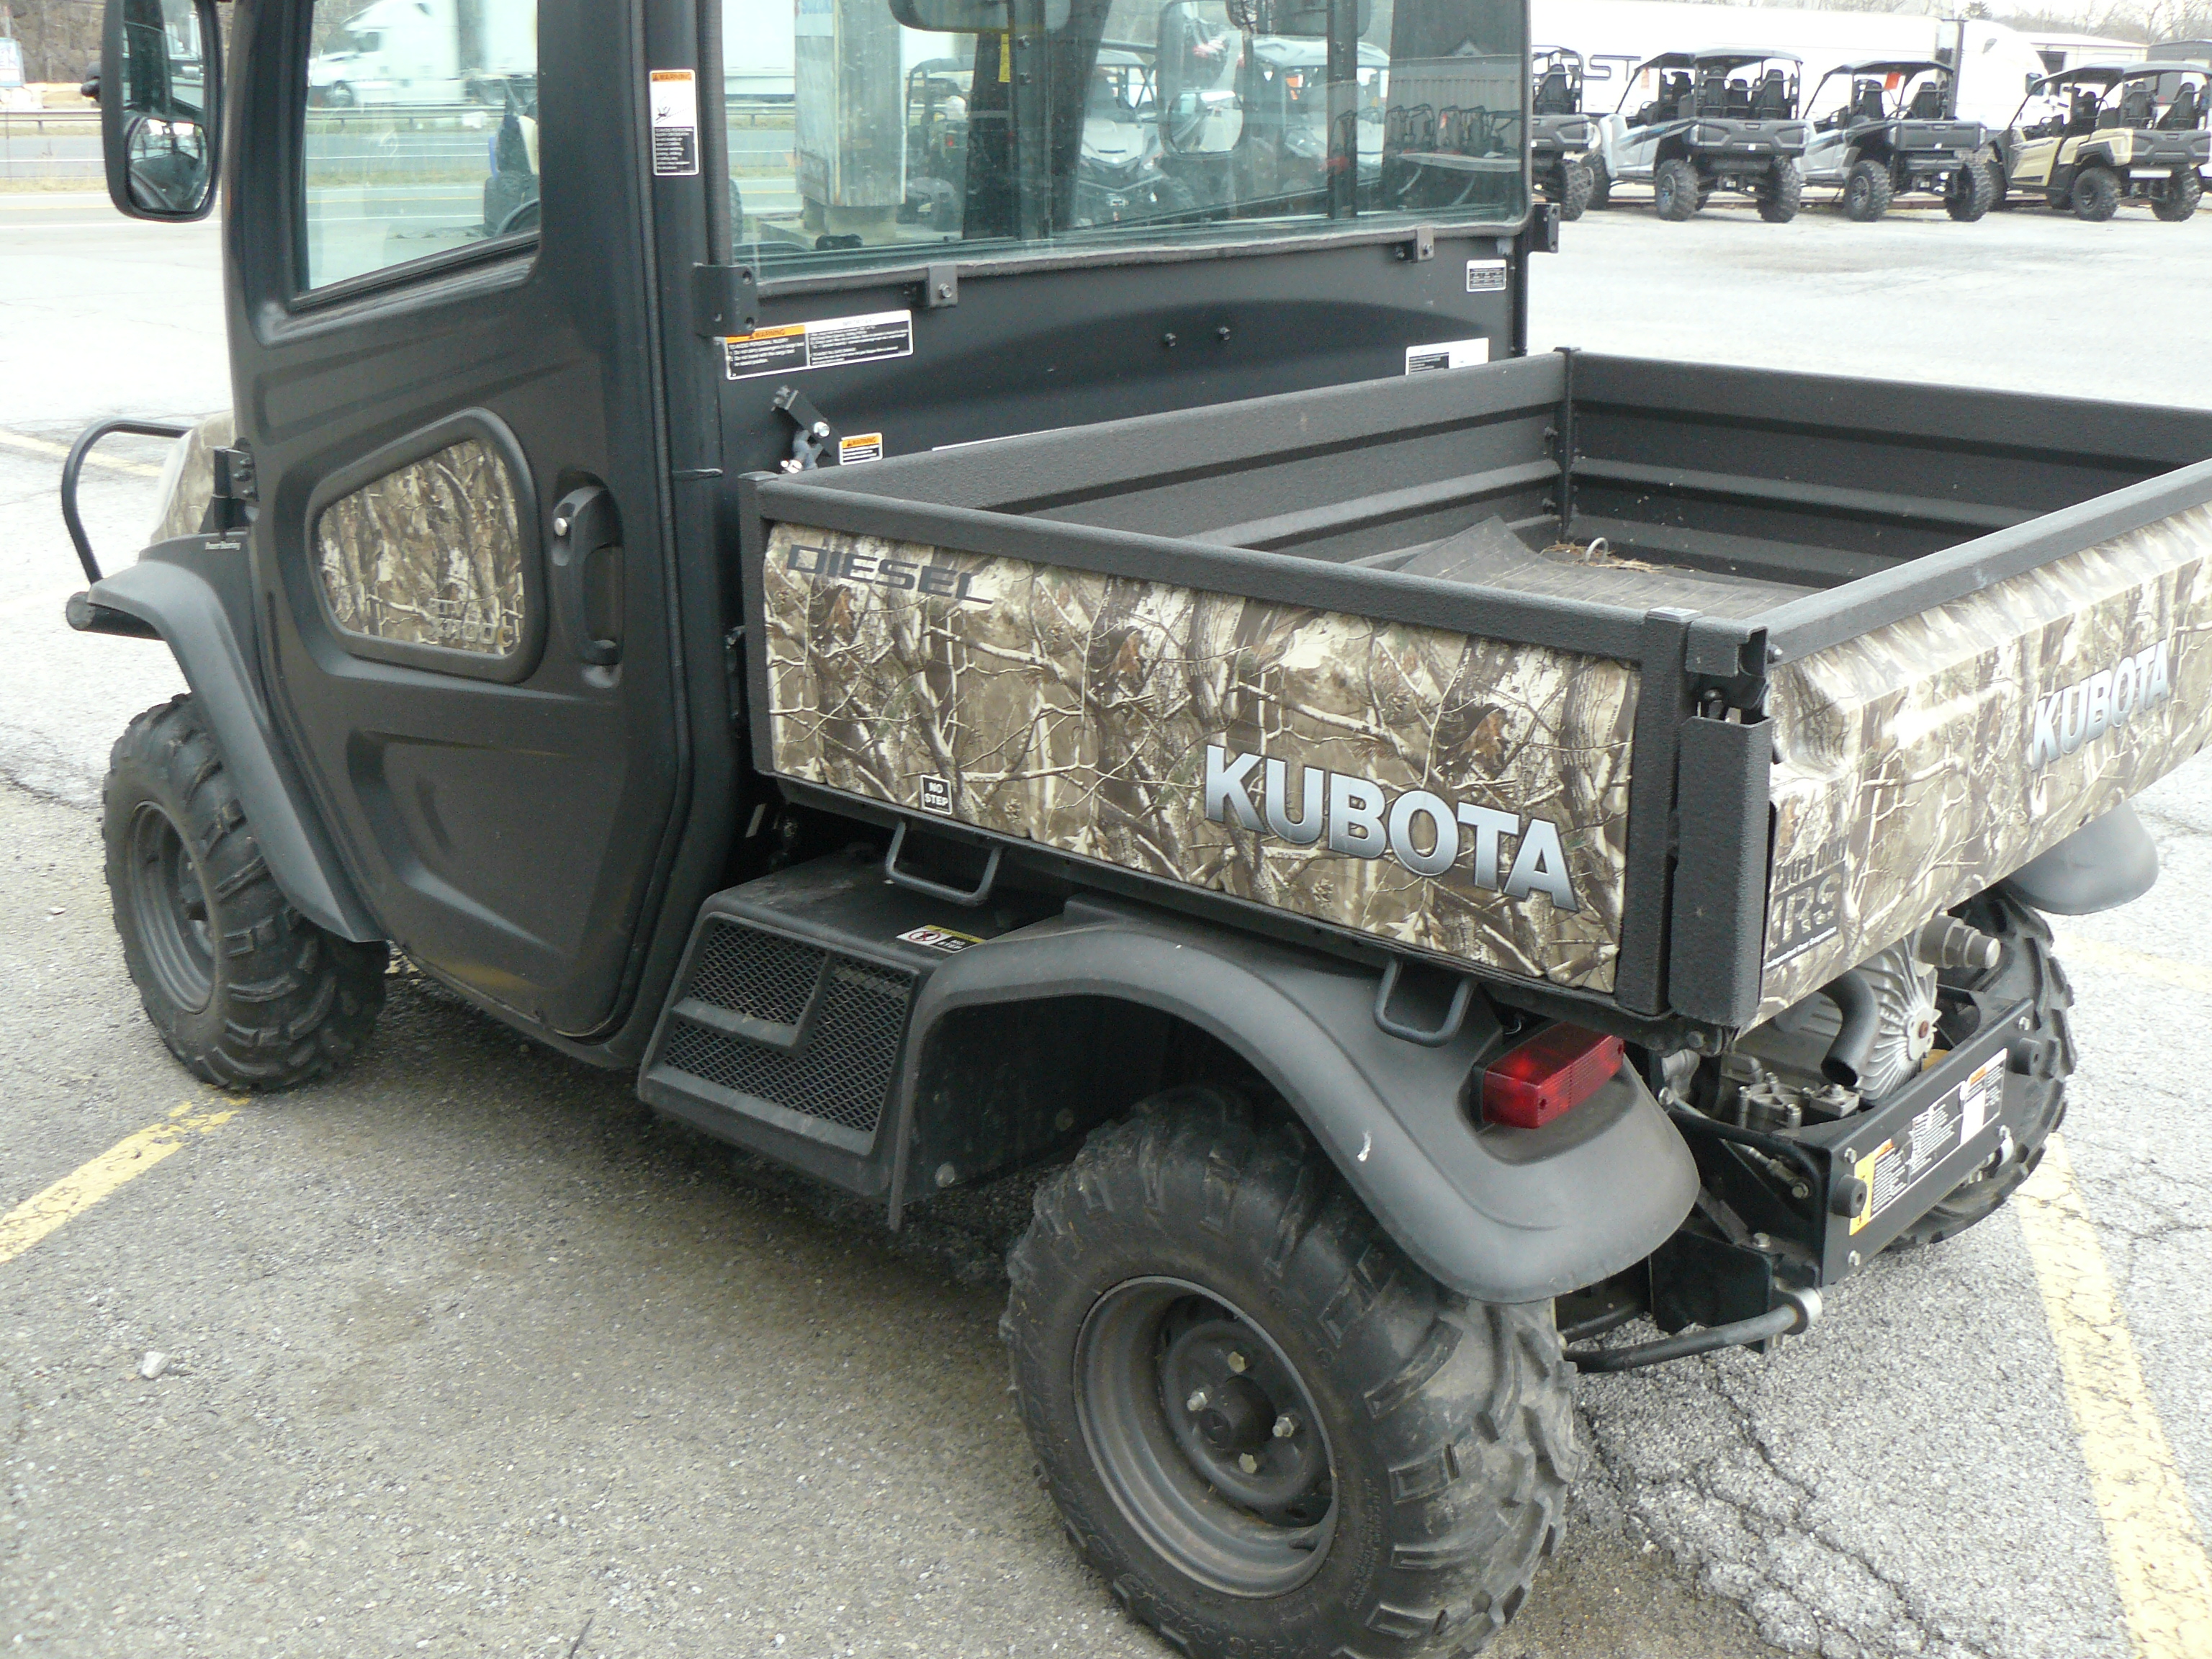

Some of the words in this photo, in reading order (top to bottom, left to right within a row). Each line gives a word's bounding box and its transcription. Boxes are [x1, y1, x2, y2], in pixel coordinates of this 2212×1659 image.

[755, 328, 786, 339] WARNING
[786, 544, 994, 605] DIESEL
[2031, 639, 2170, 773] KUBOTA
[925, 793, 949, 806] STEP
[928, 781, 944, 793] NO
[1205, 744, 1580, 913] KUBOTA
